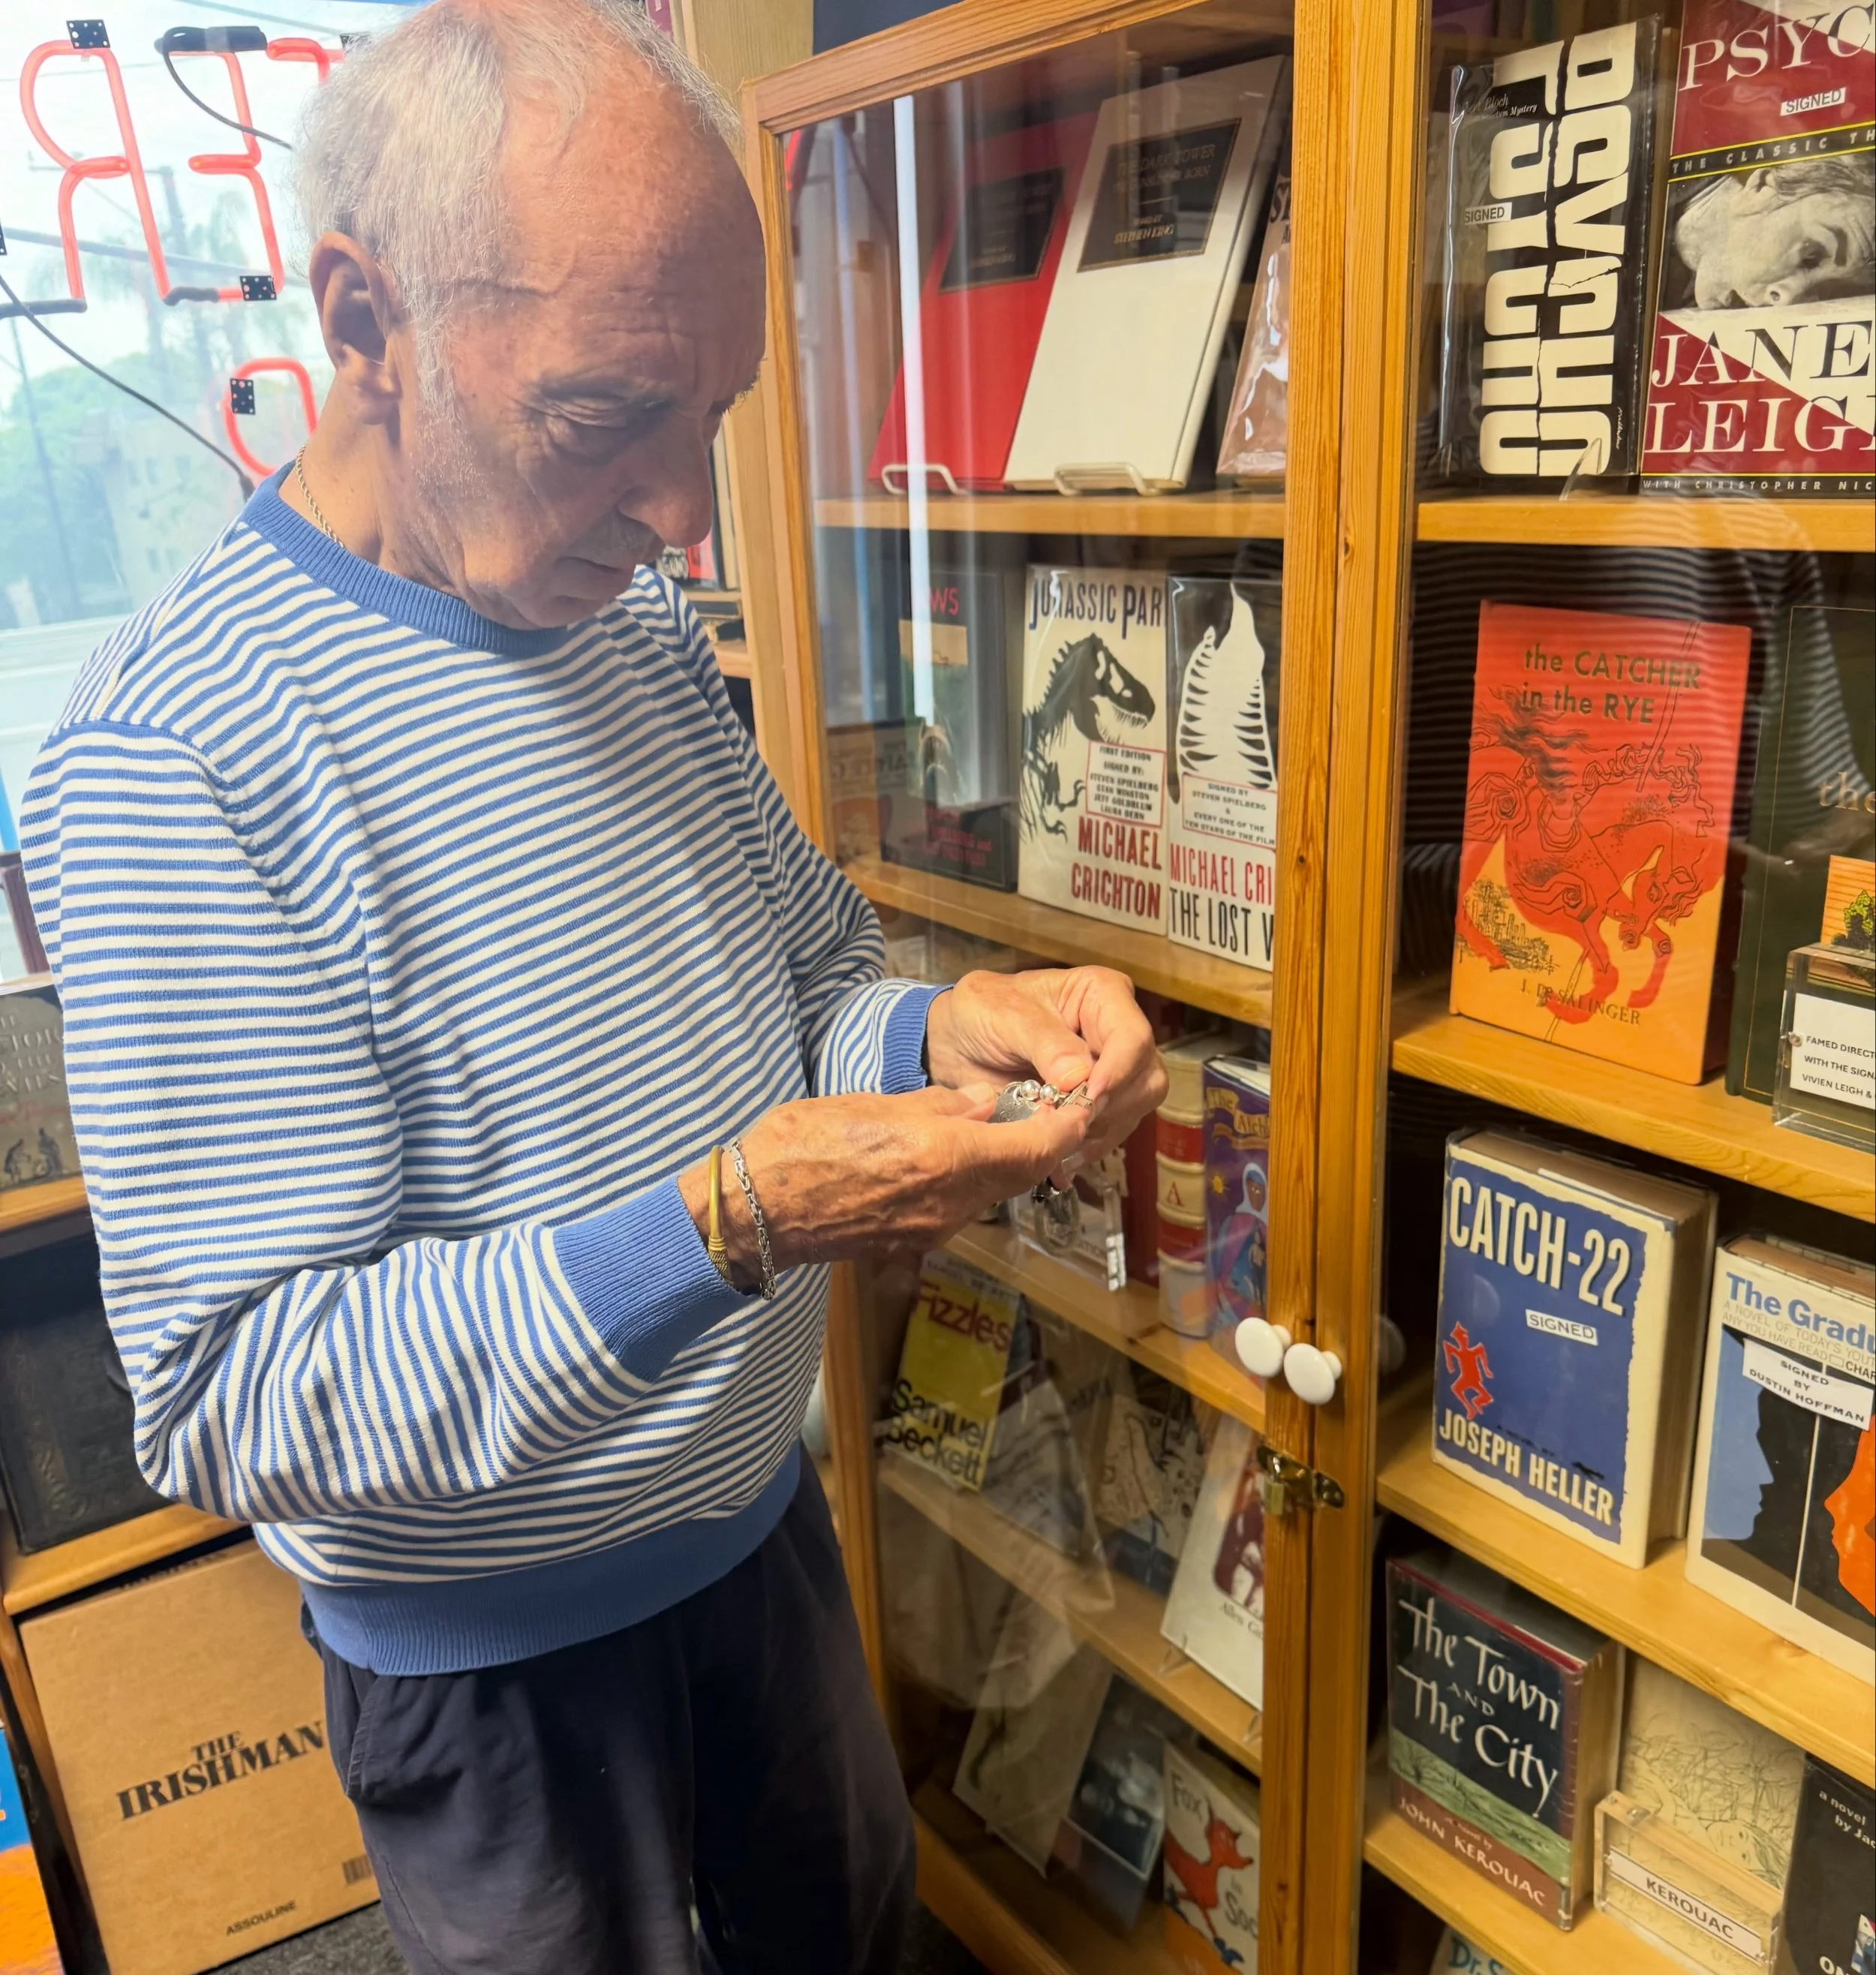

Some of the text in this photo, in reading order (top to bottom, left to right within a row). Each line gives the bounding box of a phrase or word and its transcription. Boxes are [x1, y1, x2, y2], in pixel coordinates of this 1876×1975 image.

[1510, 104, 1538, 116] Mystery
[1786, 90, 1841, 113] SIGNED
[1673, 158, 1706, 174] THE
[1726, 138, 1826, 164] CLASSIC
[1465, 207, 1505, 223] SIGNED
[1480, 22, 1637, 476] PSYCHO
[1652, 320, 1873, 387] JANE
[1643, 479, 1873, 491] WITH CHRISTOPHER NIC
[1122, 585, 1168, 639] PAR
[1526, 643, 1700, 690] the CATCHER
[1522, 682, 1655, 725] in the RYE
[1192, 790, 1267, 811] STEVEN SPIELBERG
[1193, 811, 1217, 823] EVERY
[1219, 816, 1235, 827] ONE
[1078, 816, 1162, 870] MICHAEL
[1070, 862, 1161, 920] CRICHTON
[1170, 843, 1272, 906] MICHAEL CRI
[1169, 886, 1201, 941] THE
[1207, 897, 1252, 957] LOST
[1559, 988, 1641, 1026] SALINGER
[1804, 1054, 1828, 1068] WITH
[1831, 1061, 1848, 1073] THE
[1805, 1036, 1874, 1060] FAMED DIRECT
[1802, 1074, 1872, 1099] VIVIEN LEIGH &
[1449, 1176, 1631, 1317] CATCH-22
[913, 1279, 1012, 1351] Fizzles
[1726, 1270, 1782, 1316] The
[1529, 1313, 1595, 1340] SIGNED
[1722, 1312, 1742, 1326] ANY
[1745, 1322, 1766, 1338] YOU
[1769, 1330, 1796, 1349] HAVE
[1798, 1340, 1829, 1362] READ
[1723, 1300, 1731, 1309] A
[1735, 1303, 1771, 1327] NOVEL
[1775, 1320, 1792, 1333] OF
[1796, 1327, 1844, 1354] TODAY'S
[1781, 1359, 1829, 1386] SIGNED
[1793, 1379, 1811, 1392] BY
[891, 1378, 988, 1453] Samuel
[1749, 1369, 1865, 1423] DUSTIN HOFFMAN
[1439, 1408, 1614, 1526] JOSEPH HELLER
[1398, 1596, 1561, 1730] The Town
[1447, 1681, 1496, 1717] AND
[192, 1730, 245, 1763] THE
[1396, 1664, 1559, 1819] The City
[116, 1720, 325, 1822] IRISHMAN
[1819, 1790, 1867, 1826] a novel
[1835, 1814, 1852, 1833] by
[1399, 1797, 1546, 1907] JOHN KEROUAC
[227, 1899, 296, 1937] ASSOULINE
[1646, 1877, 1734, 1940] KEROUAC
